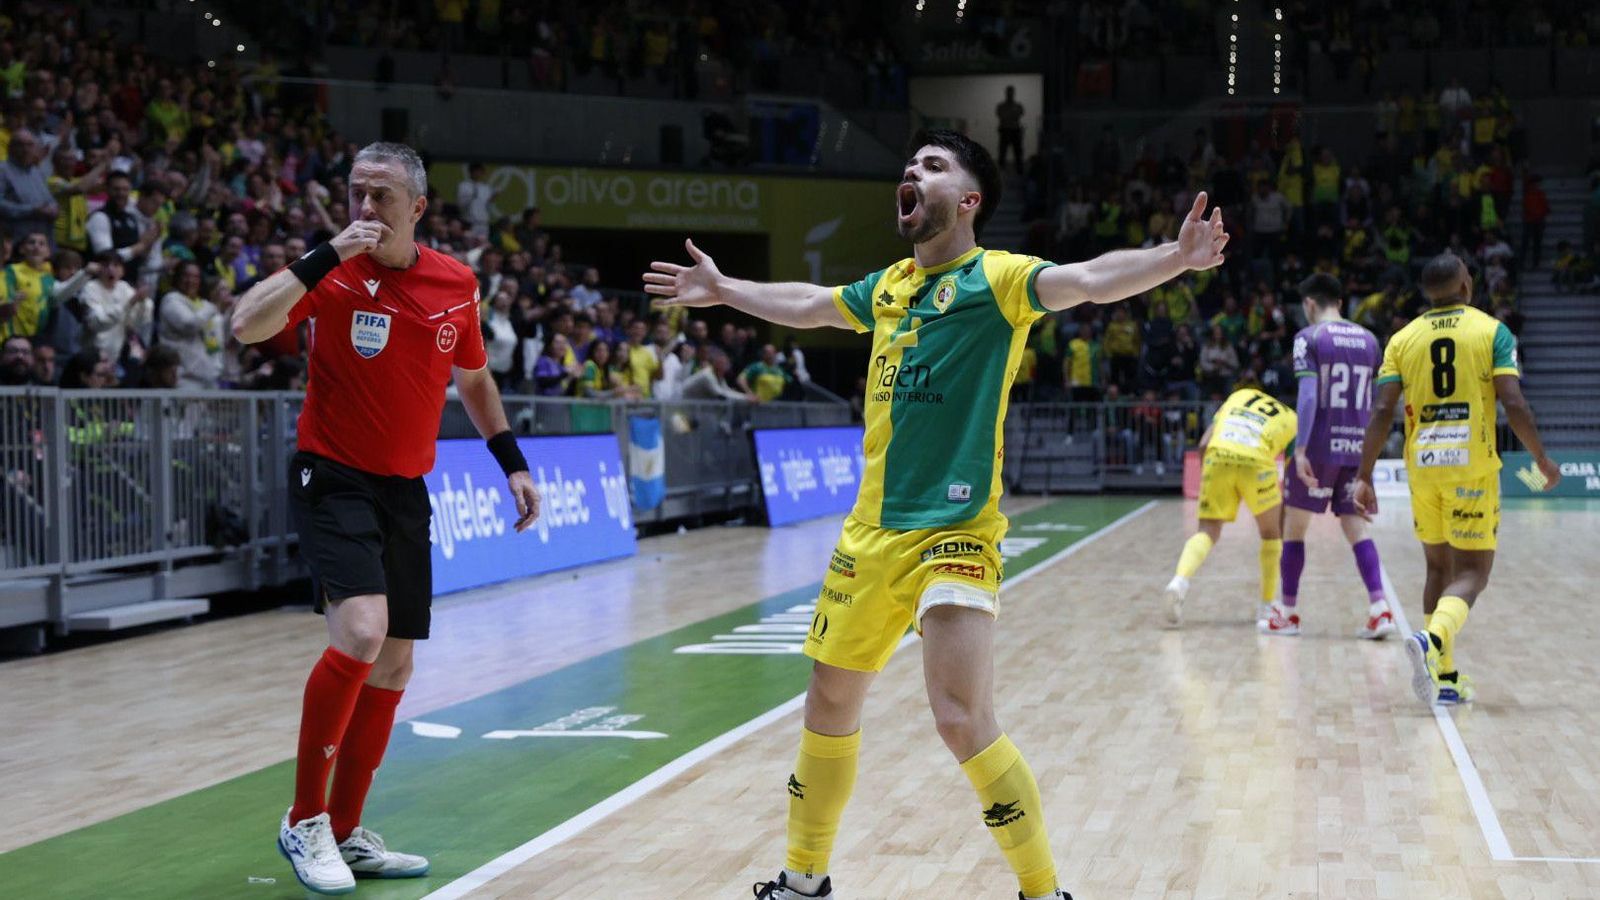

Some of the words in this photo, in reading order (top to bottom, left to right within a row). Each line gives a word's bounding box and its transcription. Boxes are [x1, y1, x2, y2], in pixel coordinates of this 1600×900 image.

[919, 40, 986, 61] Salid
[1009, 27, 1032, 59] 6
[544, 168, 636, 206] olivo
[650, 176, 760, 210] arena
[355, 313, 387, 329] FIFA
[1431, 317, 1460, 330] SANZ
[442, 329, 454, 337] RF
[440, 338, 452, 346] EF
[875, 355, 931, 389] Jaén
[1430, 337, 1456, 398] 8
[892, 391, 944, 404] INTERIOR
[1559, 462, 1596, 477] CAJA
[920, 541, 983, 562] DEDIM
